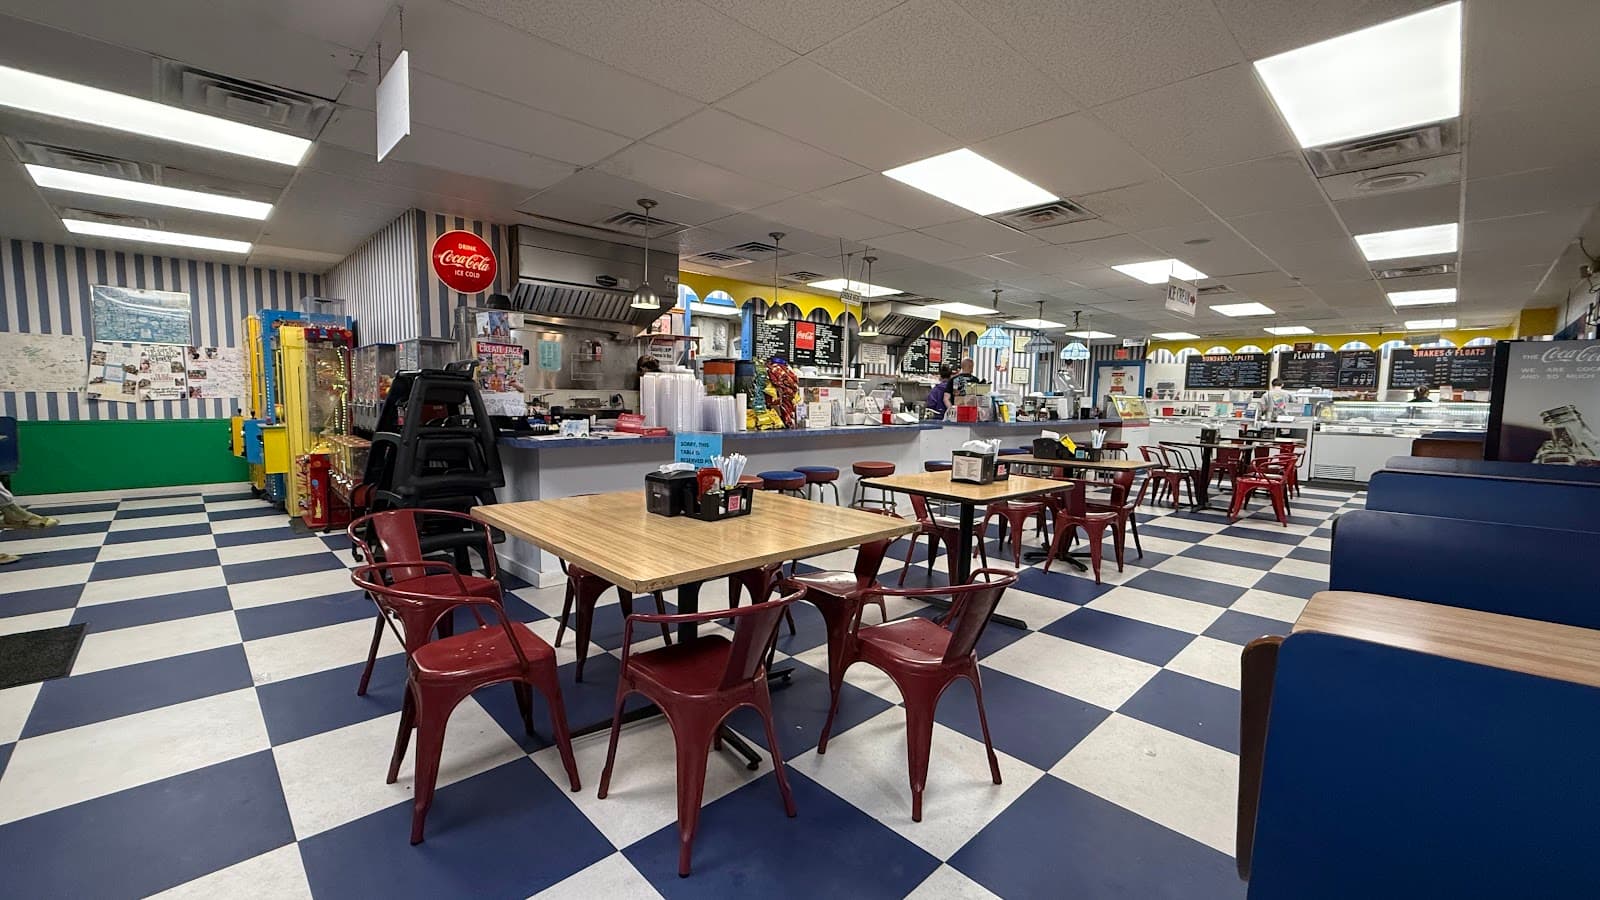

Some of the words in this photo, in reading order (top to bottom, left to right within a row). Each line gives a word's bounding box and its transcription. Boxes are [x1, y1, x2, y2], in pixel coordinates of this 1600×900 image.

[458, 243, 477, 251] DRINK
[438, 249, 490, 271] Coca-Cola
[1168, 284, 1176, 300] ICE
[1293, 352, 1326, 360] FLAVORS
[1413, 349, 1445, 357] SHAKES
[1445, 349, 1454, 357] &
[1454, 348, 1486, 356] FLOATS
